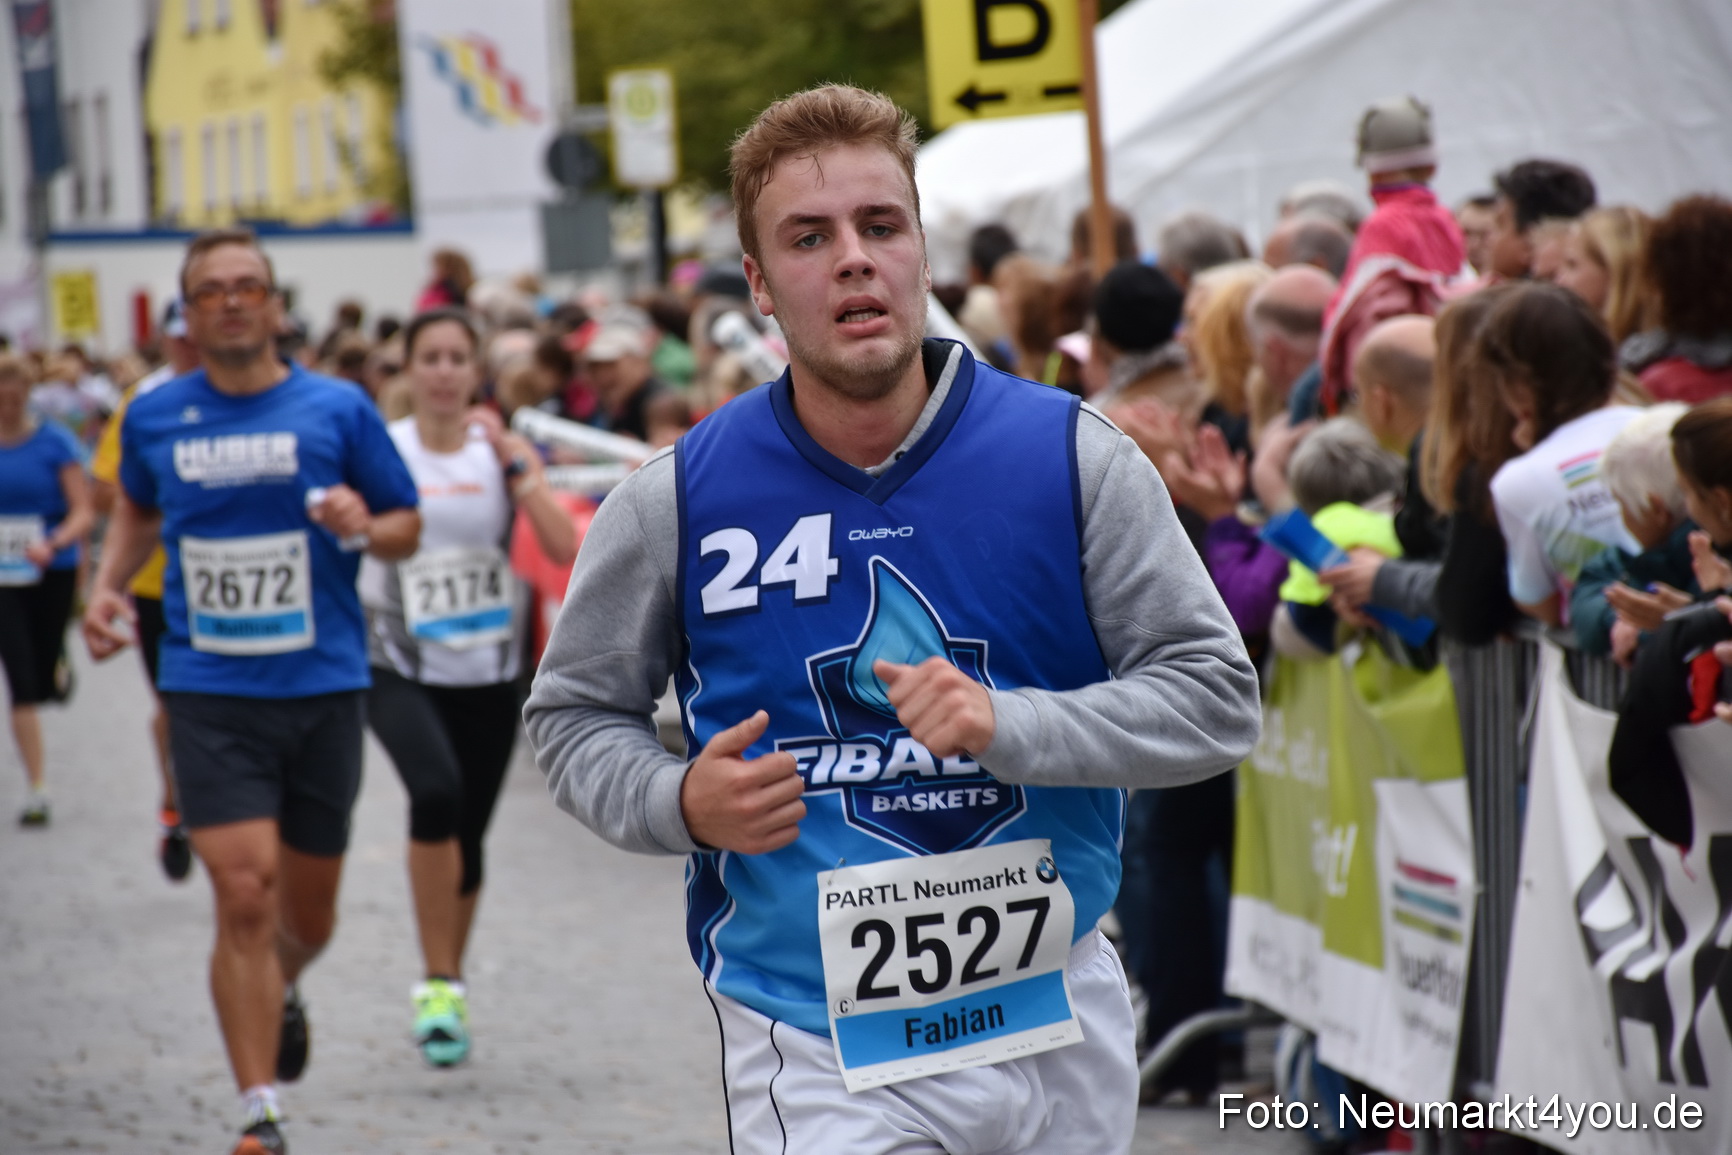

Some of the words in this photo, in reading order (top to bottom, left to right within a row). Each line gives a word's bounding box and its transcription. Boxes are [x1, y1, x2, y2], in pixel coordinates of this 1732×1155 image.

[173, 431, 299, 470] HUBER
[195, 563, 297, 611] 2672
[700, 512, 839, 615] 24
[418, 562, 501, 614] 2174
[871, 787, 999, 813] BASKETS
[825, 883, 907, 911] PARTL
[914, 866, 1028, 900] Neumarkt
[851, 896, 1051, 1001] 2527
[904, 1002, 1005, 1048] Fabian
